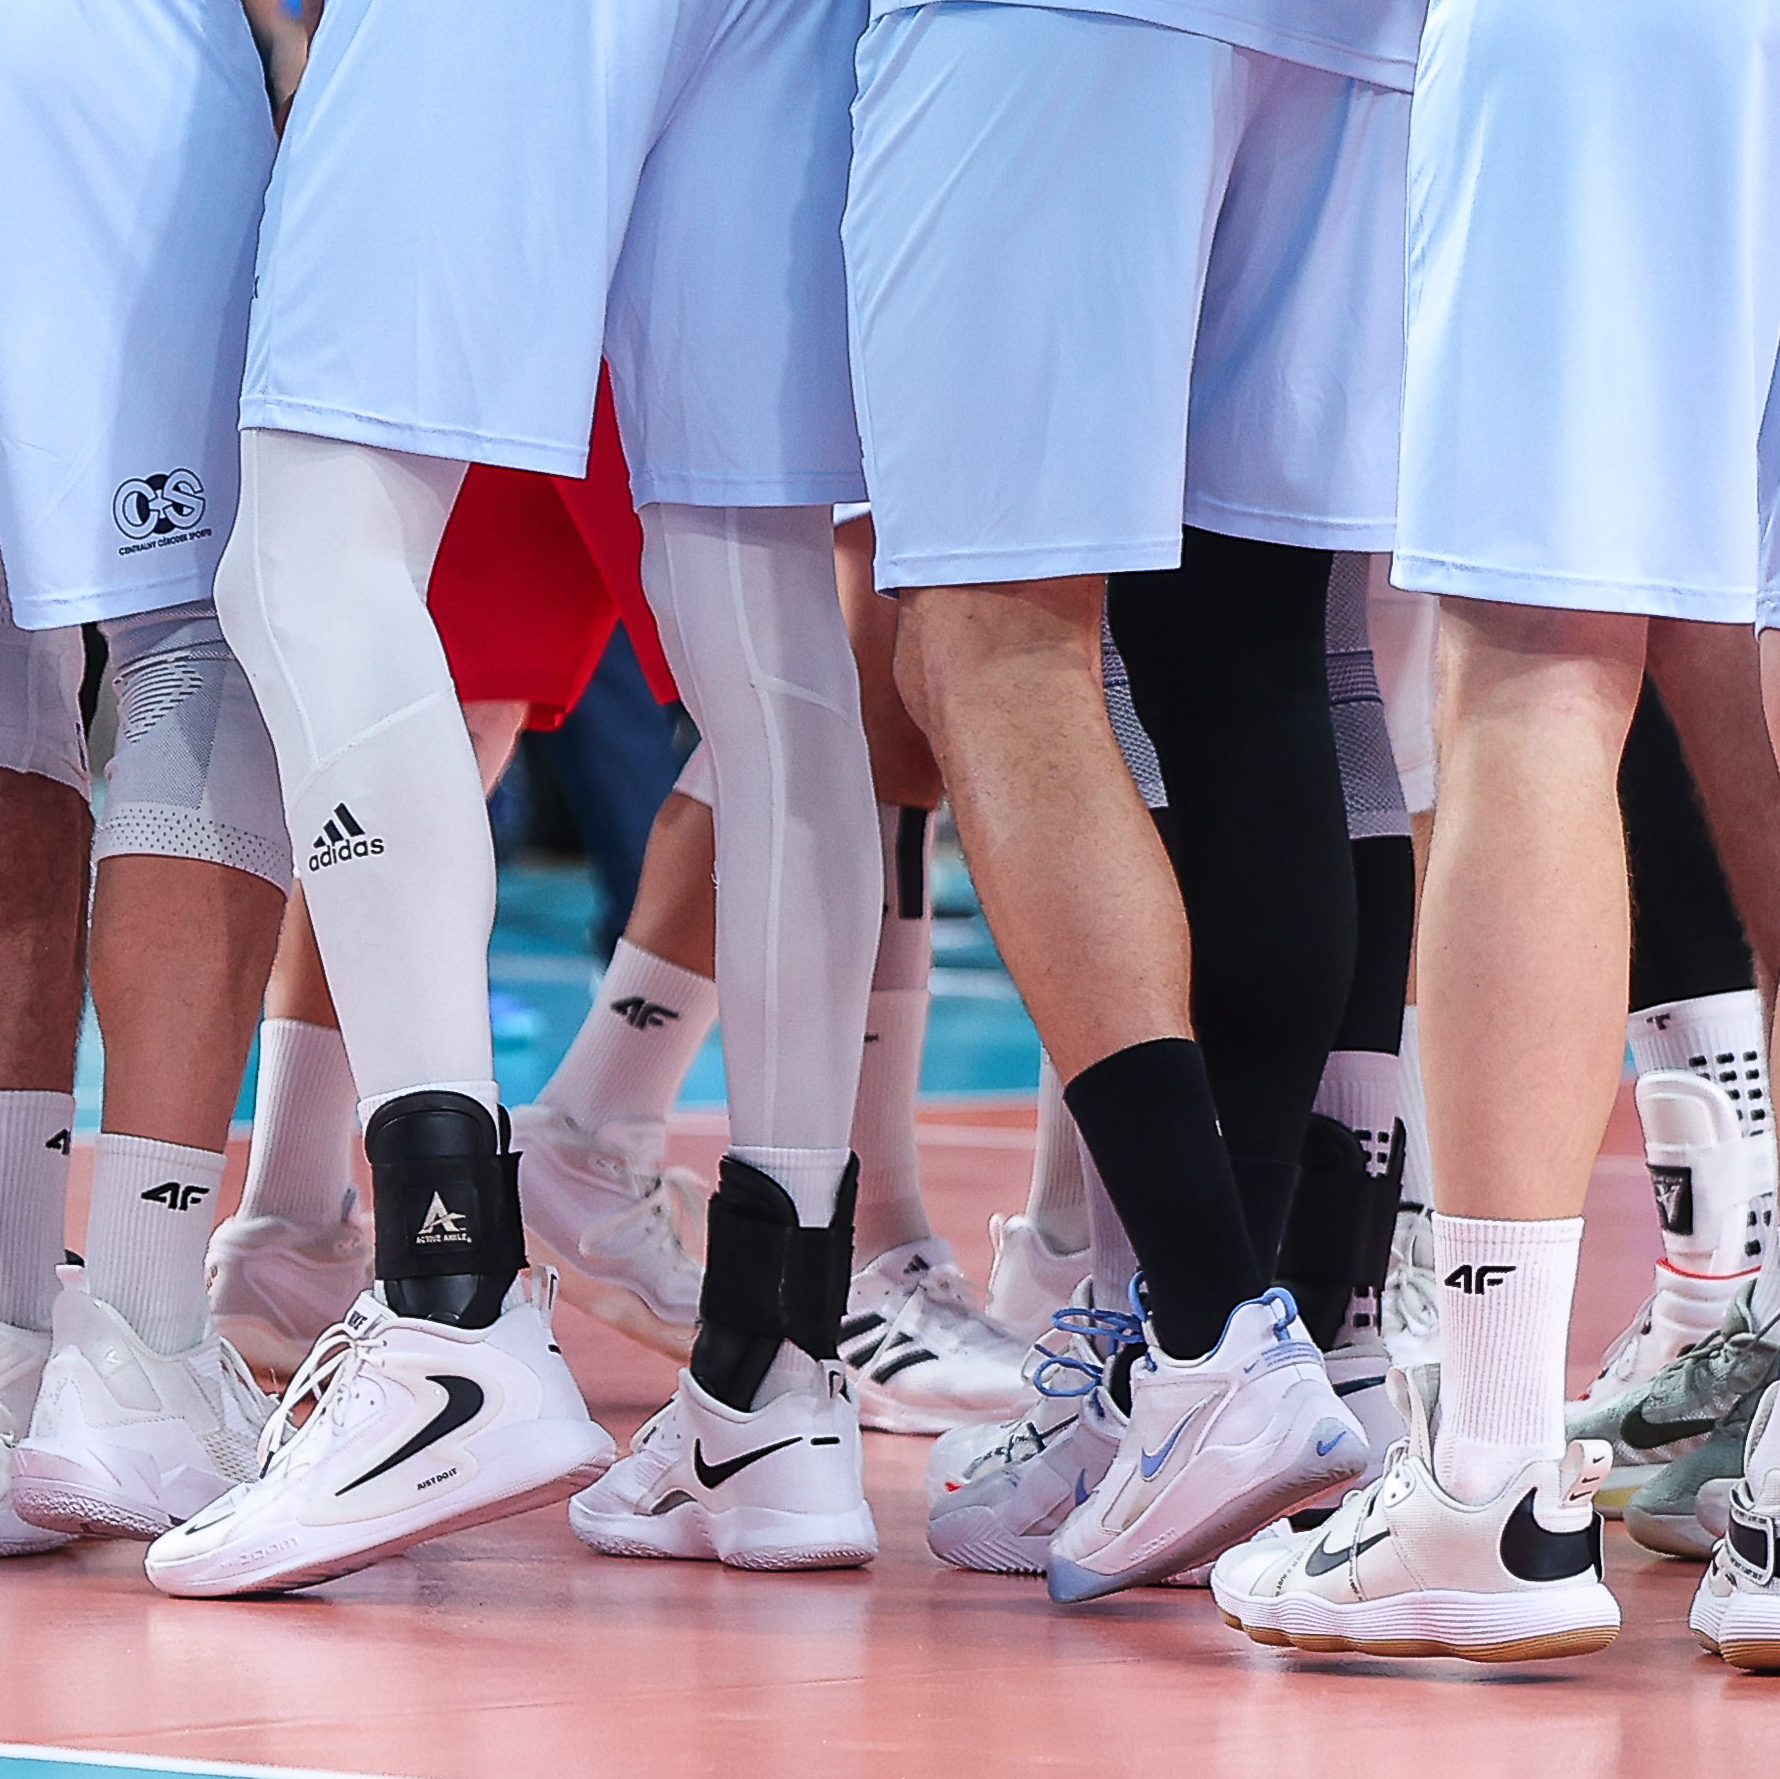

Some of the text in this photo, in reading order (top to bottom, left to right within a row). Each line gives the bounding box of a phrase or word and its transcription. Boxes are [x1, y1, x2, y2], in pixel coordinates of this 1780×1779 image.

[308, 838, 385, 872] adidas
[610, 996, 681, 1030] 4F
[140, 1181, 211, 1211] 4F
[1444, 1264, 1517, 1296] 4F
